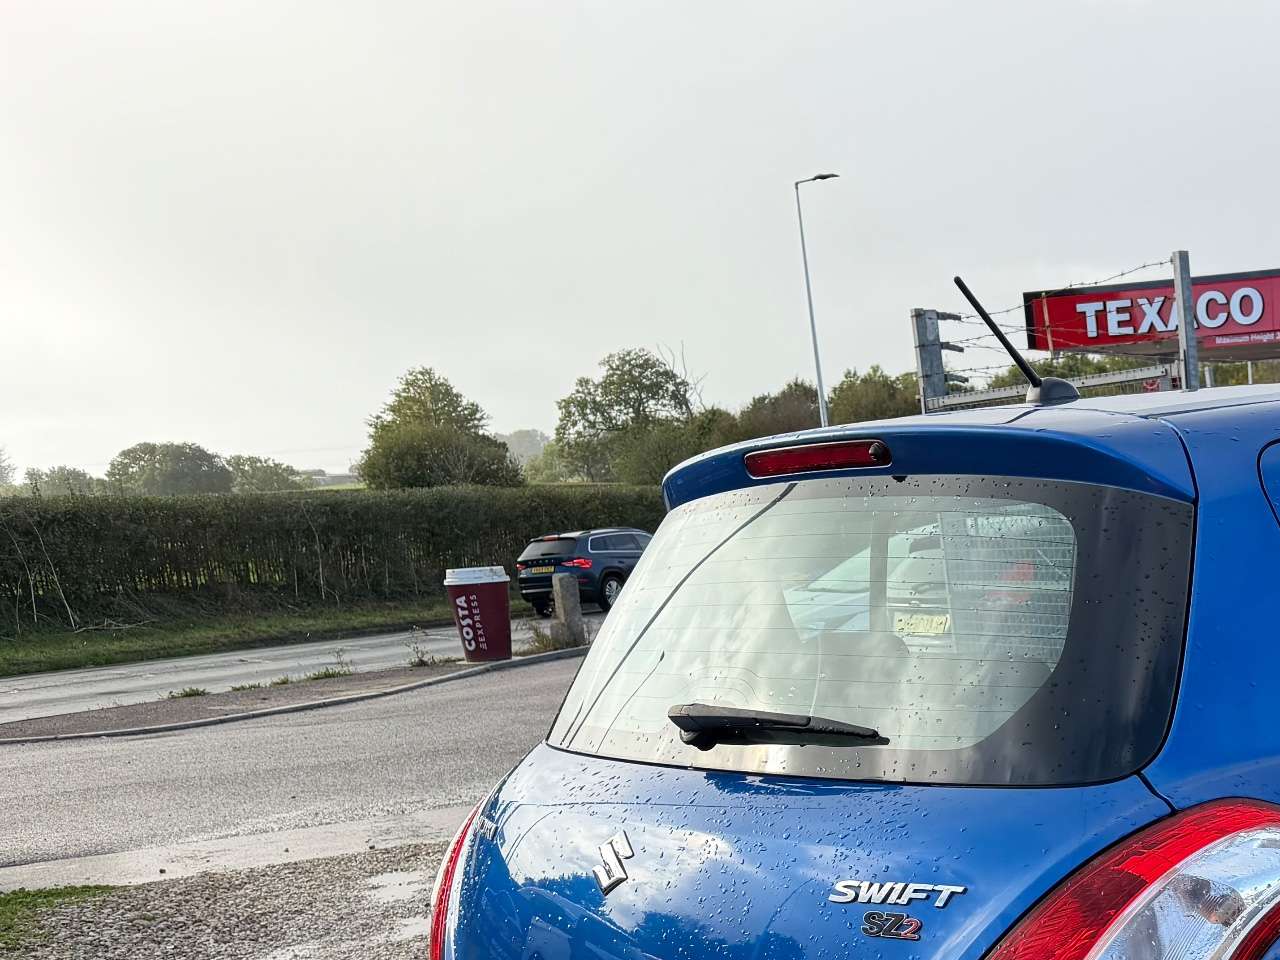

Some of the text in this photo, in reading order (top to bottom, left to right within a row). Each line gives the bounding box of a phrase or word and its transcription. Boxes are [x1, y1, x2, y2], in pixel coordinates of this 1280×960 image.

[456, 595, 476, 651] COSTA
[469, 594, 486, 642] EXPRESS
[828, 880, 968, 908] SWIFT
[861, 910, 922, 940] SZ2
